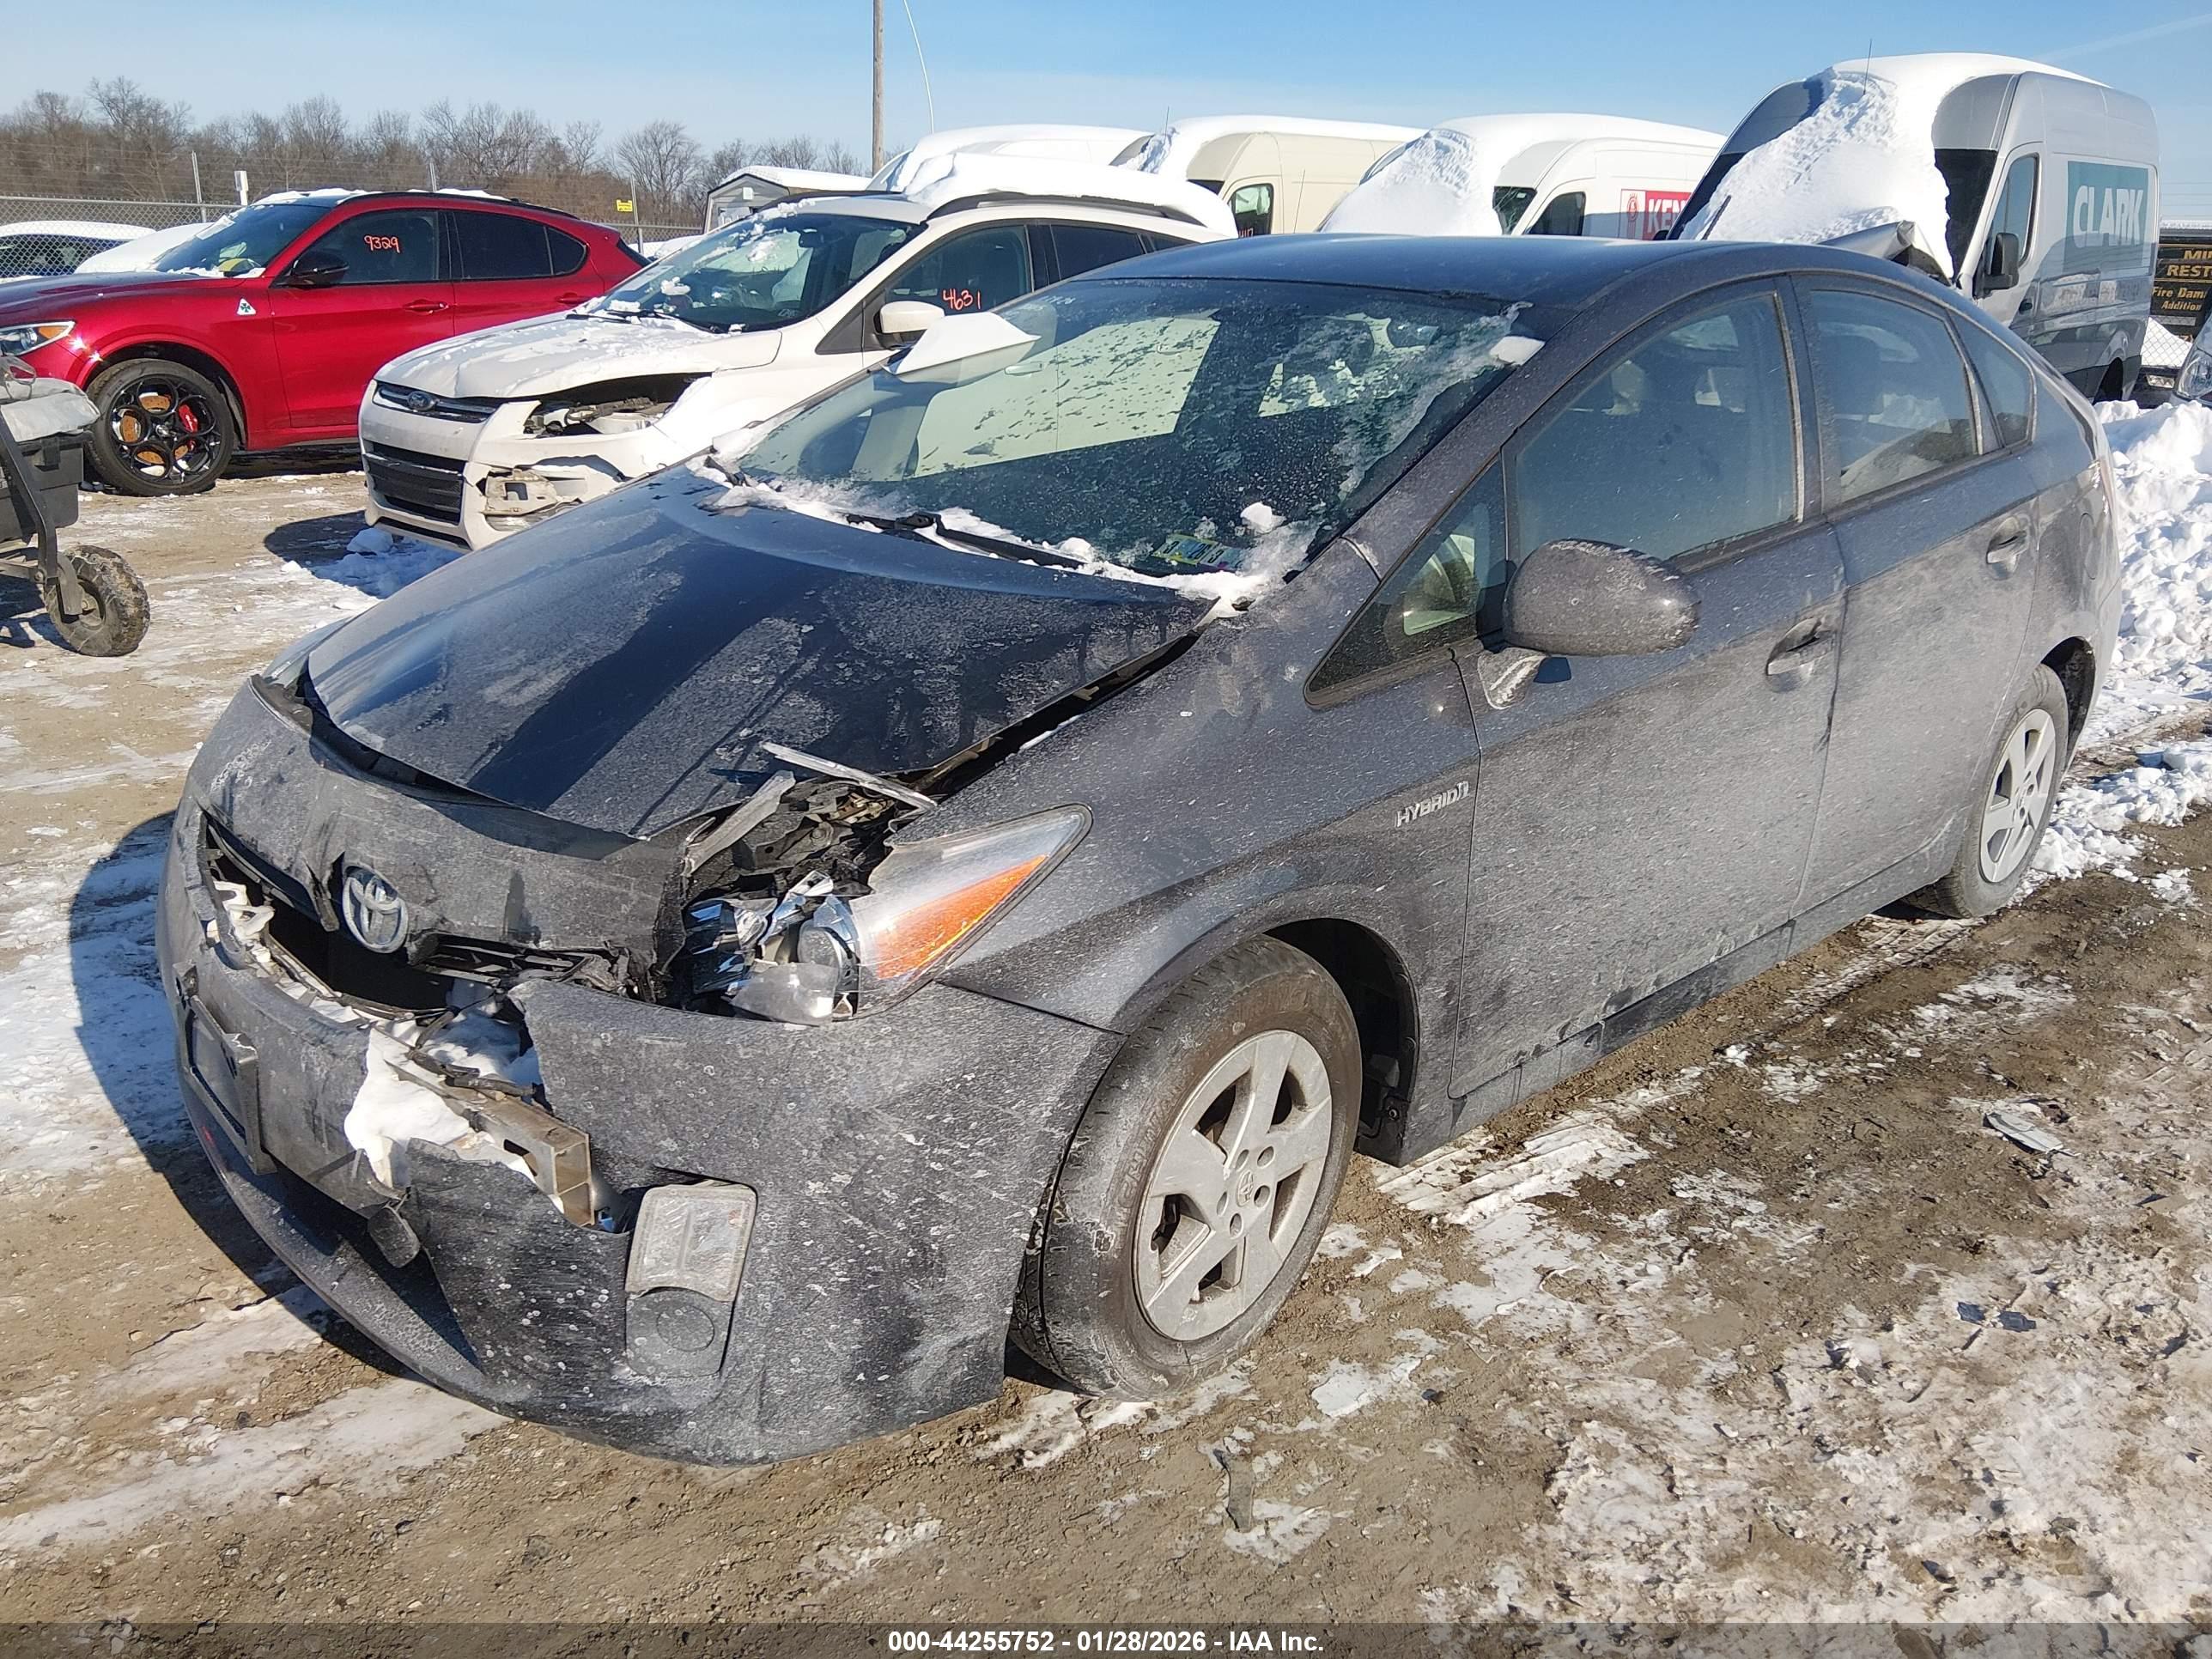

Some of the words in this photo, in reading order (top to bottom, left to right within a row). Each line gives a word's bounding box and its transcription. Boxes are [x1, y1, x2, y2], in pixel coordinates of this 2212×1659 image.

[2073, 185, 2143, 248] CLARK
[364, 235, 400, 253] 9329
[2166, 264, 2212, 277] REST
[943, 289, 981, 310] 4631
[2152, 287, 2173, 297] Fire
[1396, 787, 1459, 827] HYBRID
